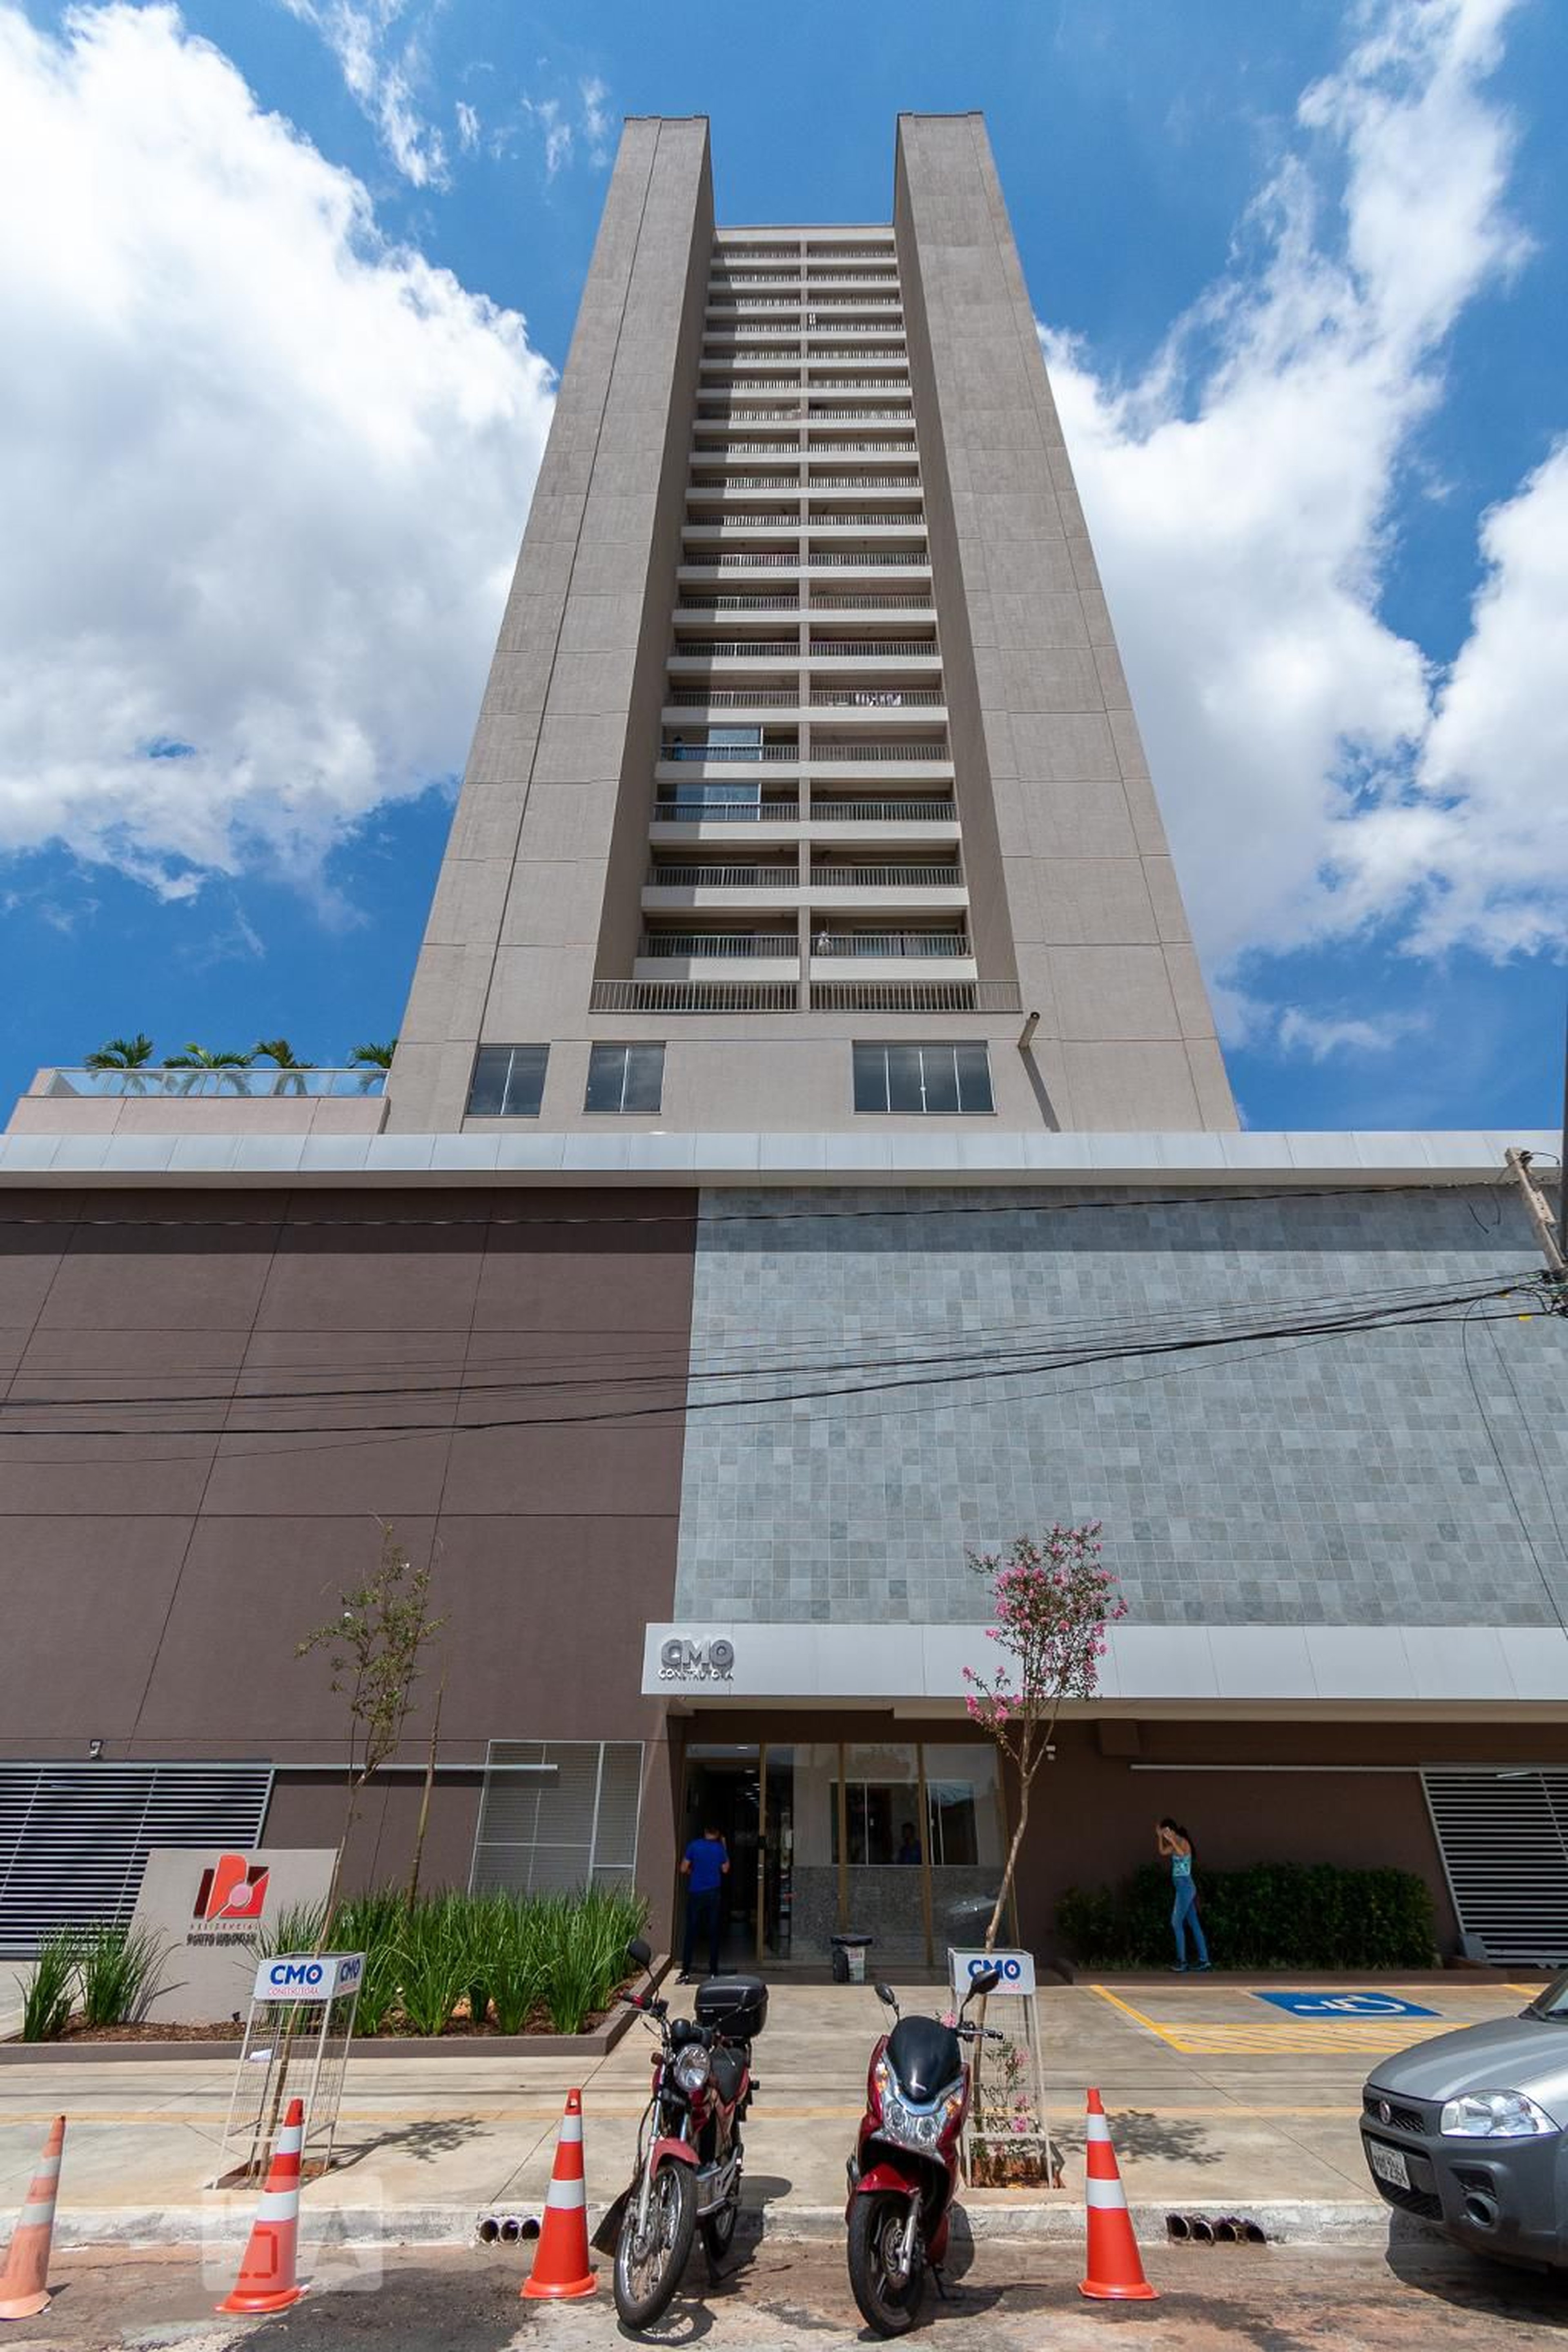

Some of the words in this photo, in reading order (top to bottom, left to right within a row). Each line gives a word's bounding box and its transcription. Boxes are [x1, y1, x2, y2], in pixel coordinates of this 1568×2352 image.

[661, 1639, 734, 1669] CMO
[270, 1964, 323, 1985] CMO
[269, 1987, 319, 1996] CONSTRUTORA
